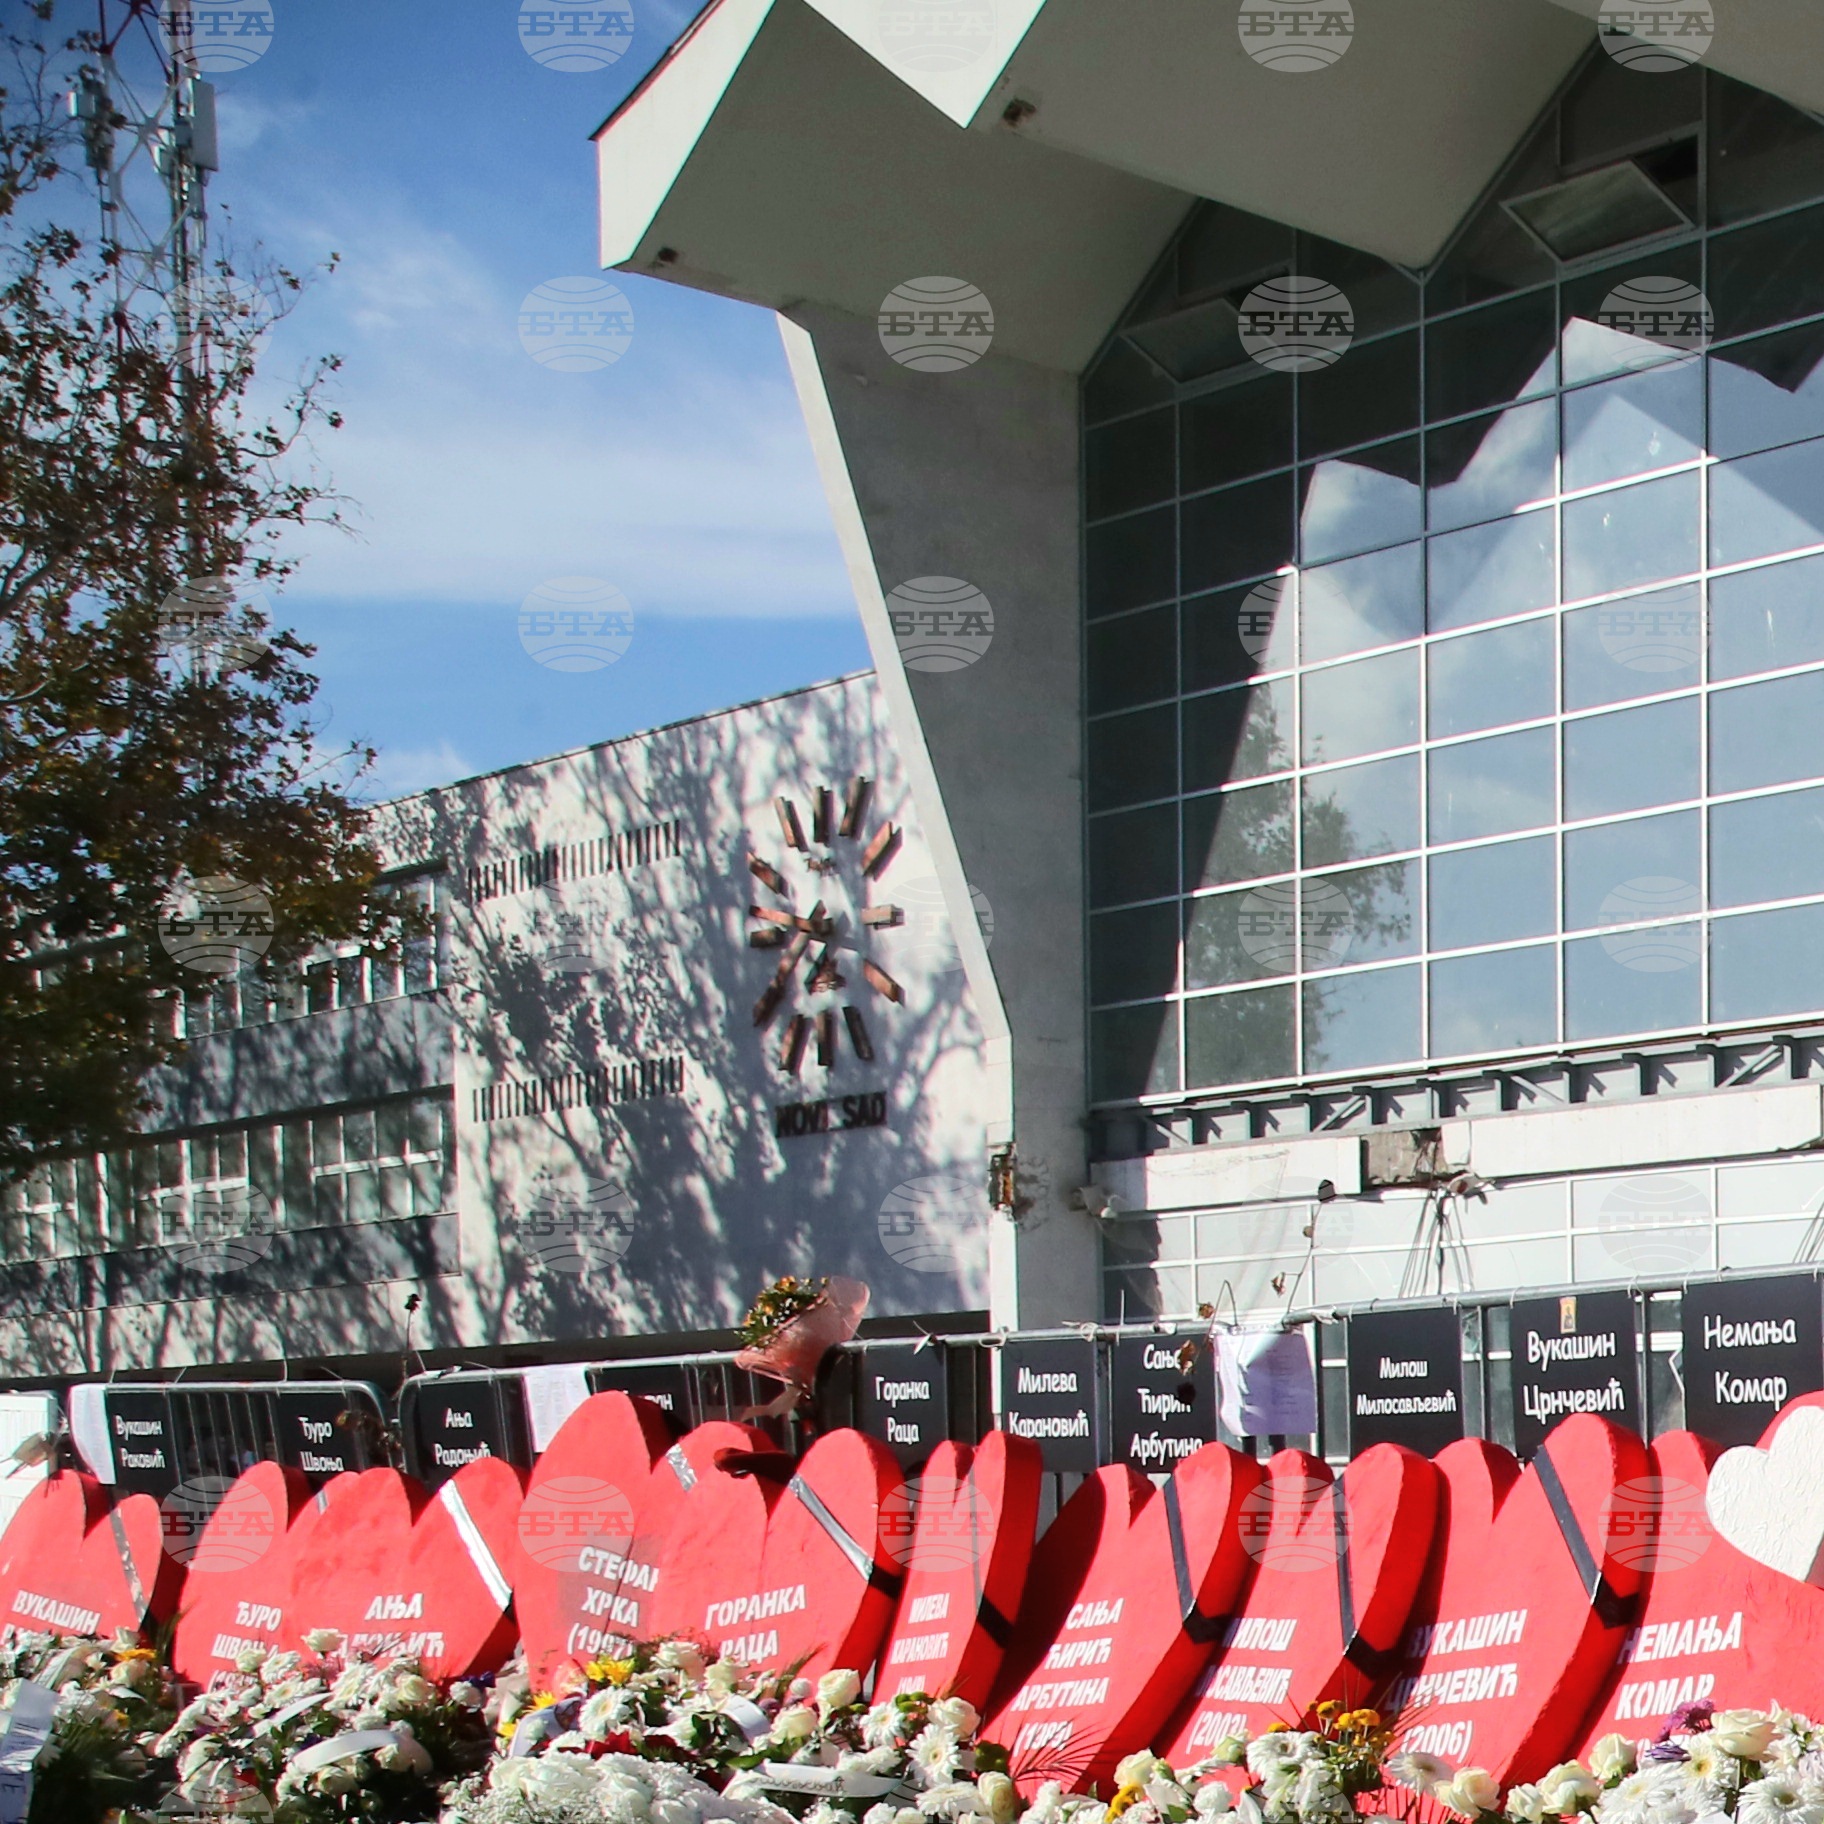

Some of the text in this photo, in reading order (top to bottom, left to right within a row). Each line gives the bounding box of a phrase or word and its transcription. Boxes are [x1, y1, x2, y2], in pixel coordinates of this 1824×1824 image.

[775, 1091, 887, 1137] NOVI SAD
[1703, 1313, 1797, 1351] Немања
[1527, 1330, 1616, 1372] Вукашин
[1018, 1367, 1077, 1393] Милева
[1379, 1357, 1429, 1380] Милош
[875, 1376, 930, 1408] Горанка
[1356, 1390, 1457, 1417] Милосављевић
[1522, 1376, 1626, 1427] Црнчевић
[1715, 1370, 1788, 1412] Комар
[114, 1415, 163, 1441] Вукашин
[299, 1417, 333, 1444] Ђуро
[445, 1408, 473, 1429] Ања
[887, 1416, 920, 1444] Раца
[1008, 1408, 1090, 1439] Карановић
[300, 1451, 345, 1473] Швоња
[12, 1589, 101, 1635] ВУКАШИН
[235, 1602, 282, 1631] ЂУРО
[364, 1593, 423, 1619] АЊА
[581, 1587, 639, 1627] ХРКА
[704, 1585, 806, 1630] ГОРАНКА
[908, 1593, 950, 1624] МИЛЕВА
[1065, 1598, 1124, 1630] САЊА
[890, 1632, 950, 1665] КАРАНОВИЋ
[1410, 1609, 1527, 1657] ВУКАШИН
[1617, 1611, 1743, 1665] НЕМАЊА
[1045, 1638, 1112, 1670] ЋИРИЋ
[1010, 1677, 1109, 1712] АРБУТИНА
[1402, 1720, 1473, 1763] (2006)
